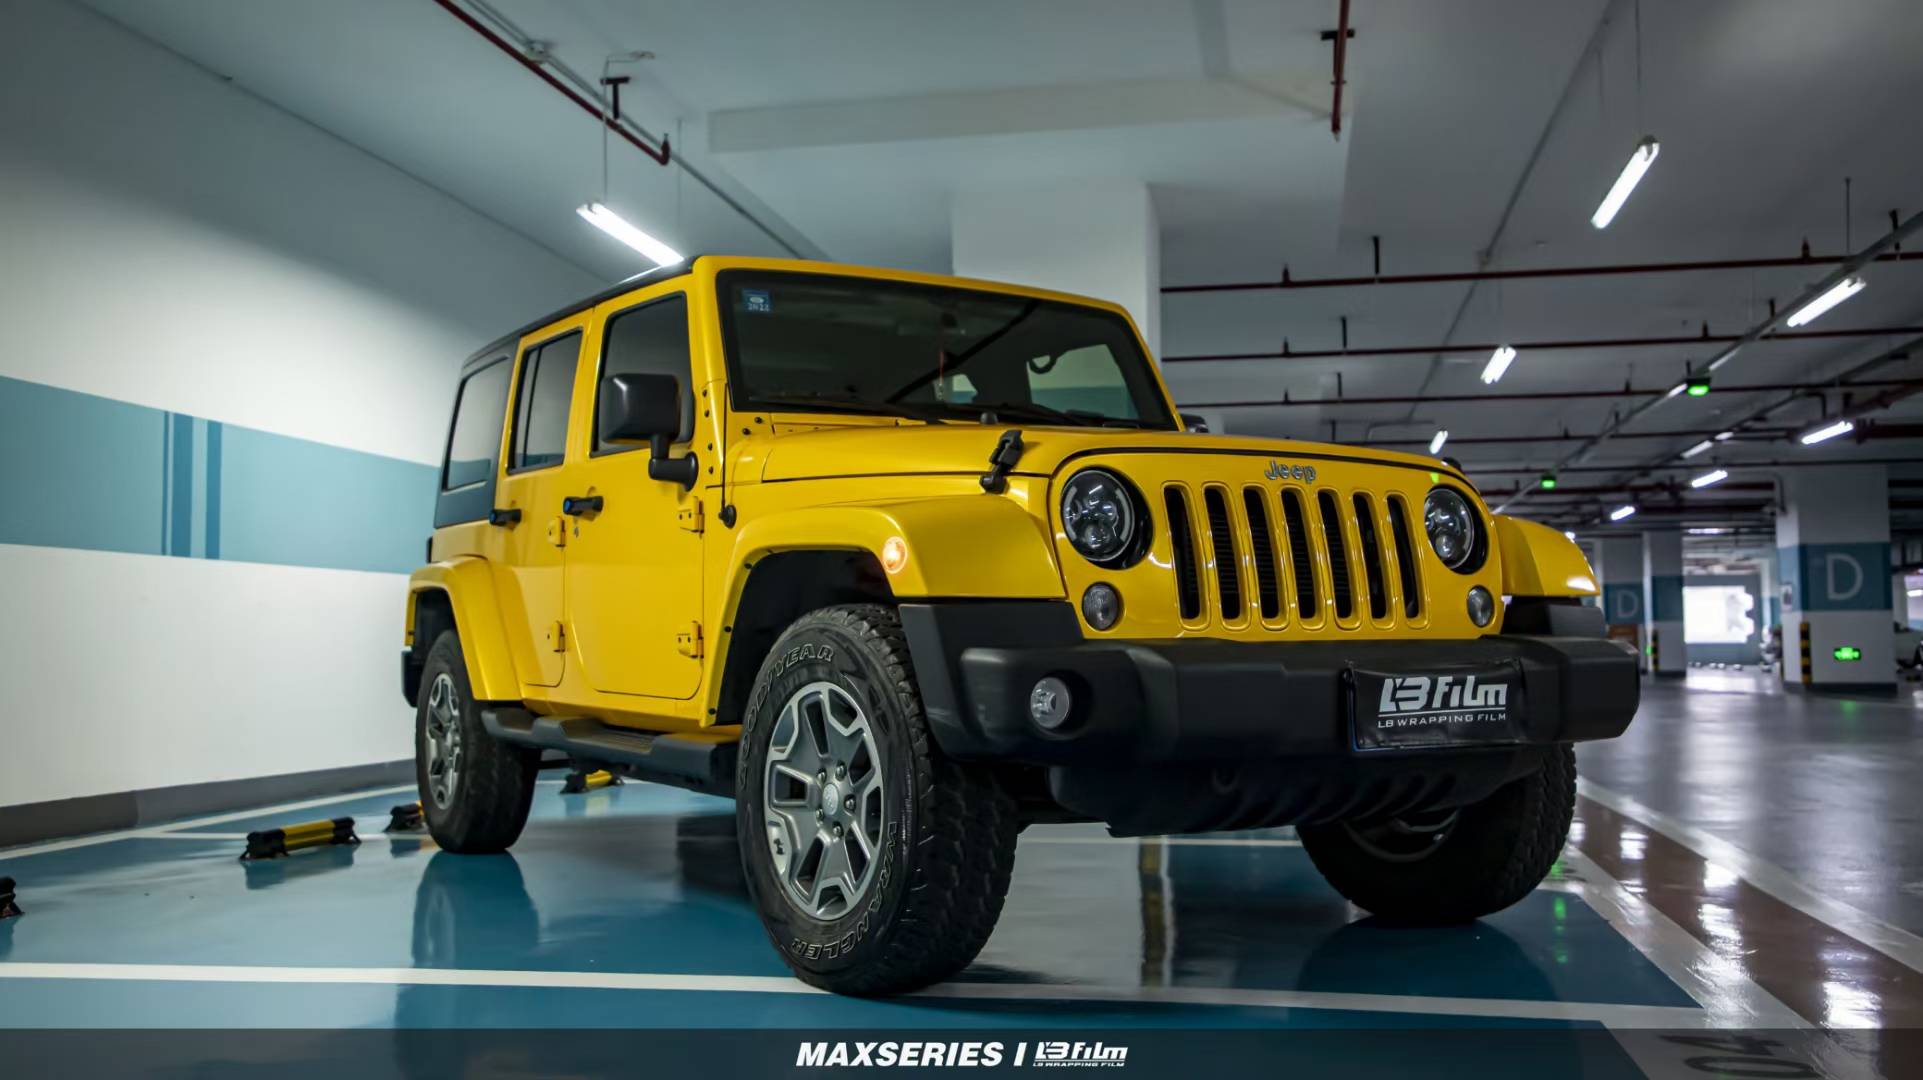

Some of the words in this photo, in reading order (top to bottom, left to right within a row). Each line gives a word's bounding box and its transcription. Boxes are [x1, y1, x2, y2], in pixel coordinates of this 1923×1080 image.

[1264, 459, 1316, 484] Jeep
[1826, 553, 1863, 600] D
[1616, 589, 1639, 618] D
[738, 643, 833, 790] GOODYEAR
[1378, 719, 1394, 728] LB
[1397, 714, 1474, 726] WRAPPING
[1477, 712, 1506, 721] FILM
